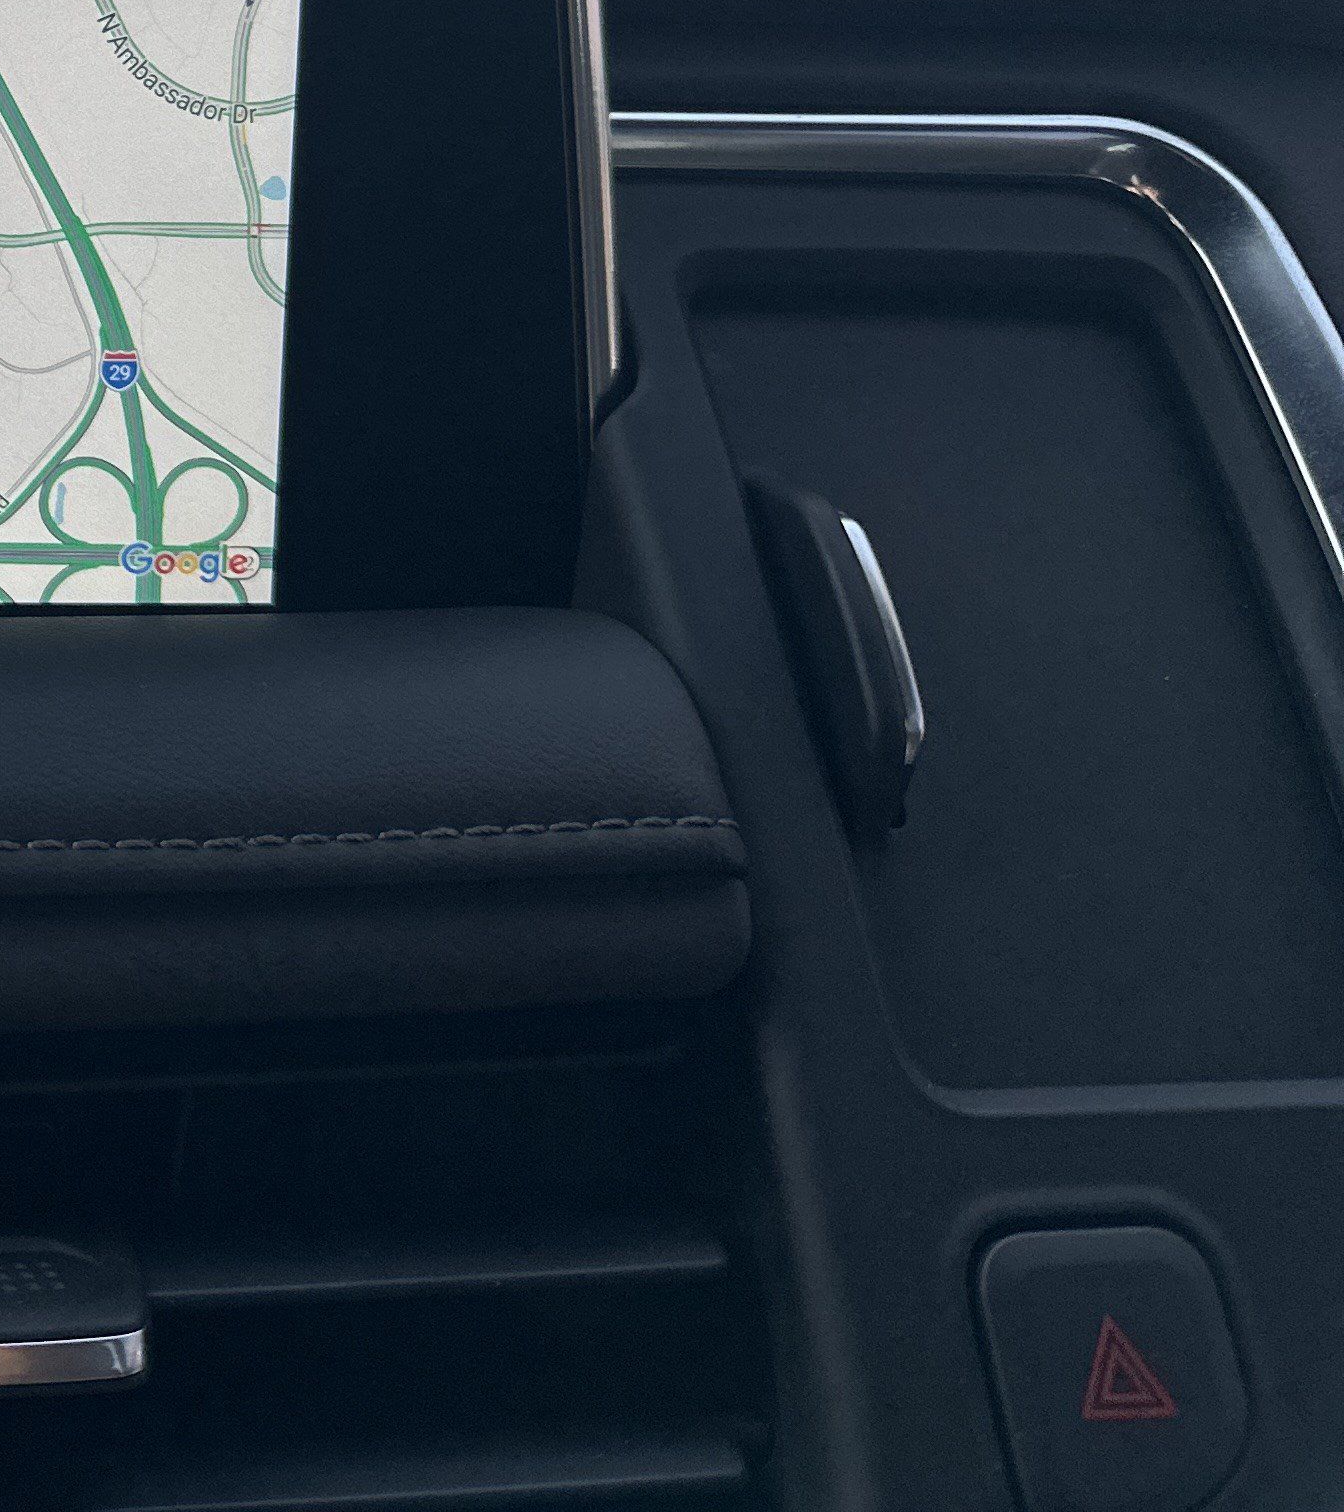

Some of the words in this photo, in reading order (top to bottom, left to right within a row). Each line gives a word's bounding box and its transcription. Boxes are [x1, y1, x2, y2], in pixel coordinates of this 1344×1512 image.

[97, 12, 120, 34] N
[107, 36, 227, 122] Ambassador
[233, 104, 258, 124] Dr
[108, 363, 131, 382] 29
[121, 542, 248, 583] Google
